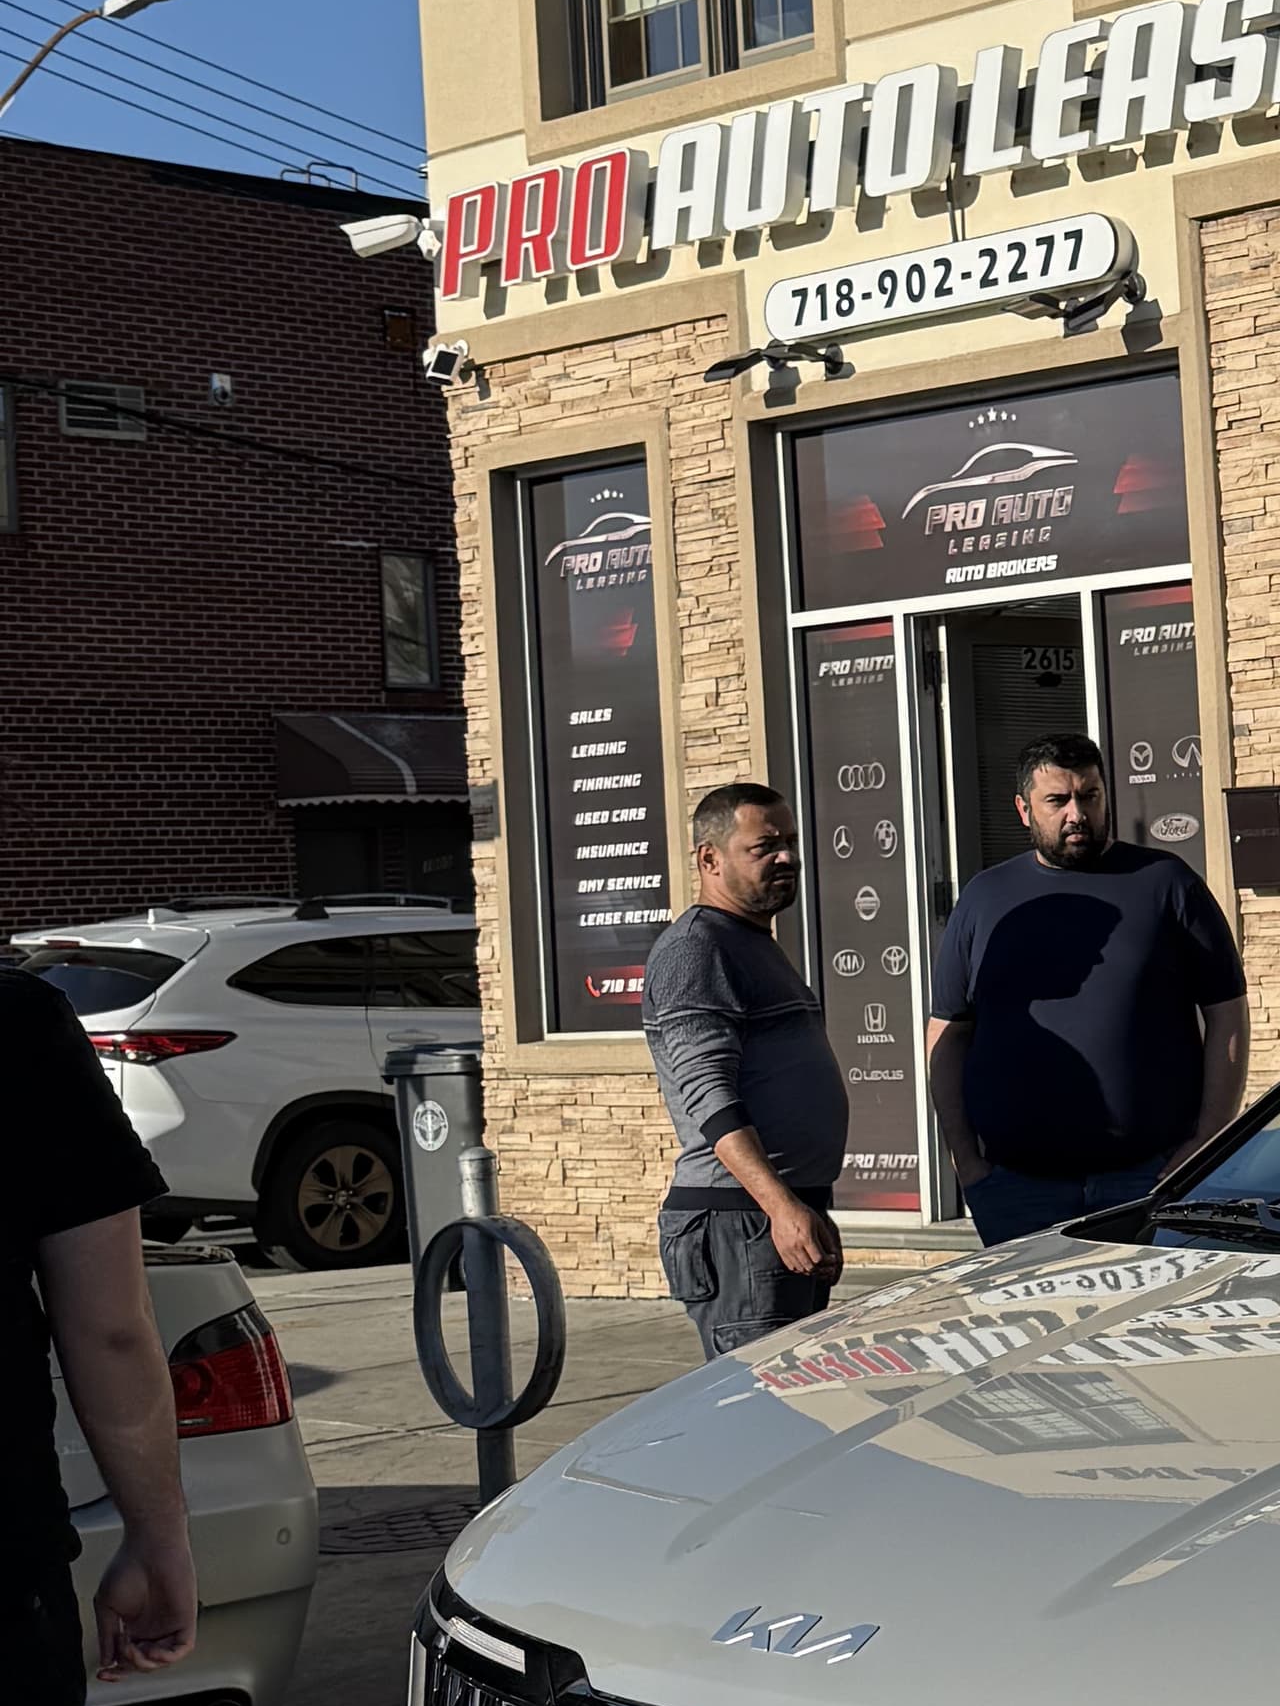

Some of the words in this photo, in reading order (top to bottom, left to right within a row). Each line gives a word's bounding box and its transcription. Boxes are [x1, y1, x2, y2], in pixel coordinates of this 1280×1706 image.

[439, 145, 648, 301] PRO
[650, 61, 970, 251] AUTO
[791, 228, 1084, 327] 718-902-2277
[926, 499, 987, 535] PRO
[992, 485, 1074, 525] AUTO
[948, 526, 1052, 555] LEASING
[560, 551, 601, 577] PRO
[946, 560, 985, 583] AUTO
[987, 555, 1058, 580] BROKERS
[1120, 626, 1156, 646] PRO
[819, 659, 851, 677] PRO
[853, 655, 894, 673] AUTO
[1023, 648, 1075, 672] 2615
[569, 708, 612, 725] SALES
[571, 741, 627, 759] LEASING
[573, 773, 642, 792] FINANCING
[574, 810, 610, 826] USED
[611, 807, 647, 824] CARS
[577, 841, 649, 860] INSURANCE
[607, 874, 662, 892] SERVICE
[580, 912, 622, 927] LEASE
[857, 1033, 895, 1045] HONDA
[863, 1069, 904, 1081] LEXUS
[842, 1154, 875, 1169] PRO
[878, 1153, 919, 1169] AUTO
[711, 1605, 882, 1665] KIA
